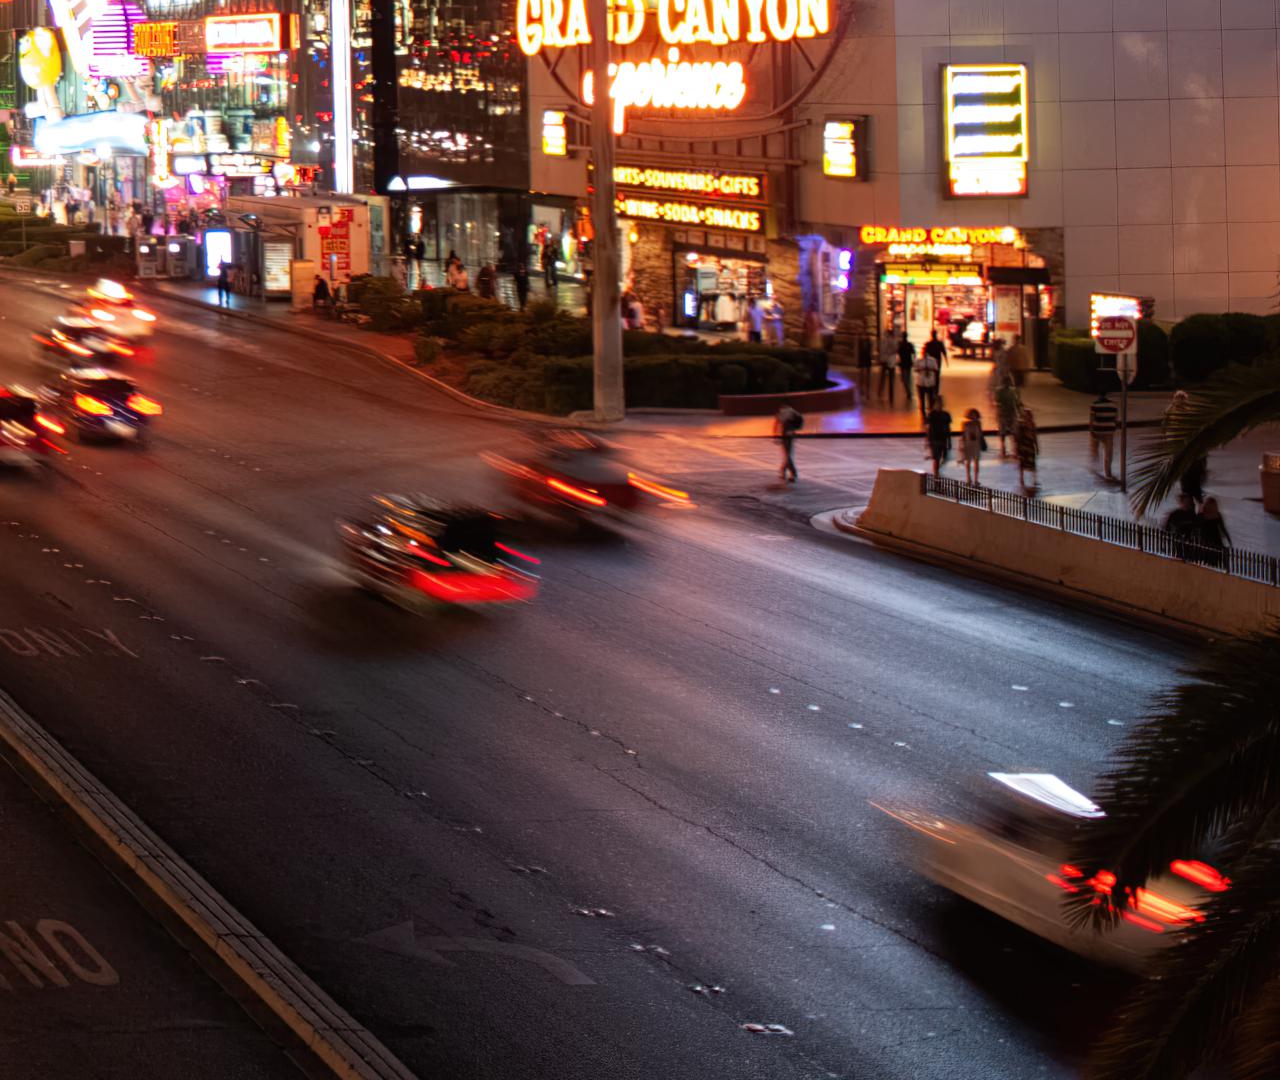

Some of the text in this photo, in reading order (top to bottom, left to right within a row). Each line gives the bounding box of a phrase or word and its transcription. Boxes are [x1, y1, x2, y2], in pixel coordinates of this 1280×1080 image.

[582, 46, 746, 135] eperience
[719, 175, 759, 196] GIFTS
[624, 198, 659, 219] WINE
[663, 202, 699, 223] SODA
[861, 225, 927, 244] GRAND
